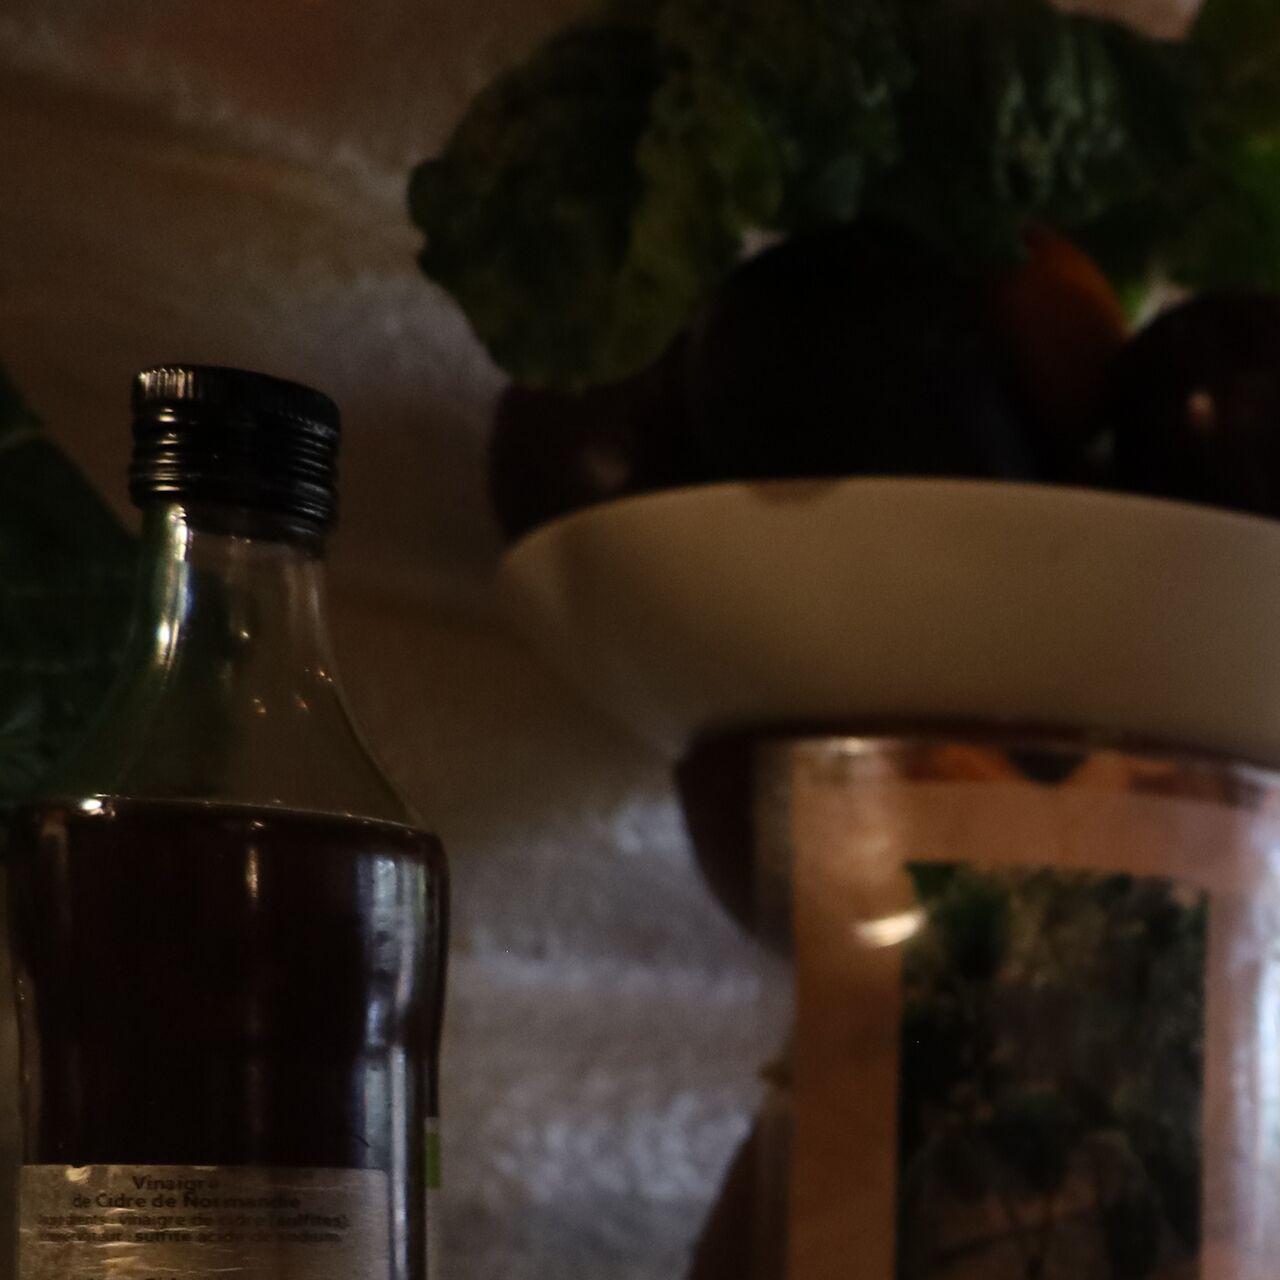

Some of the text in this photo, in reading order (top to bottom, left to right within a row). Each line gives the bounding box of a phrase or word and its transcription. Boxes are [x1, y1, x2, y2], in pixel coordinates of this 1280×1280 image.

[132, 1175, 219, 1192] Vinaigre
[73, 1192, 299, 1208] de Cidre de Normandie
